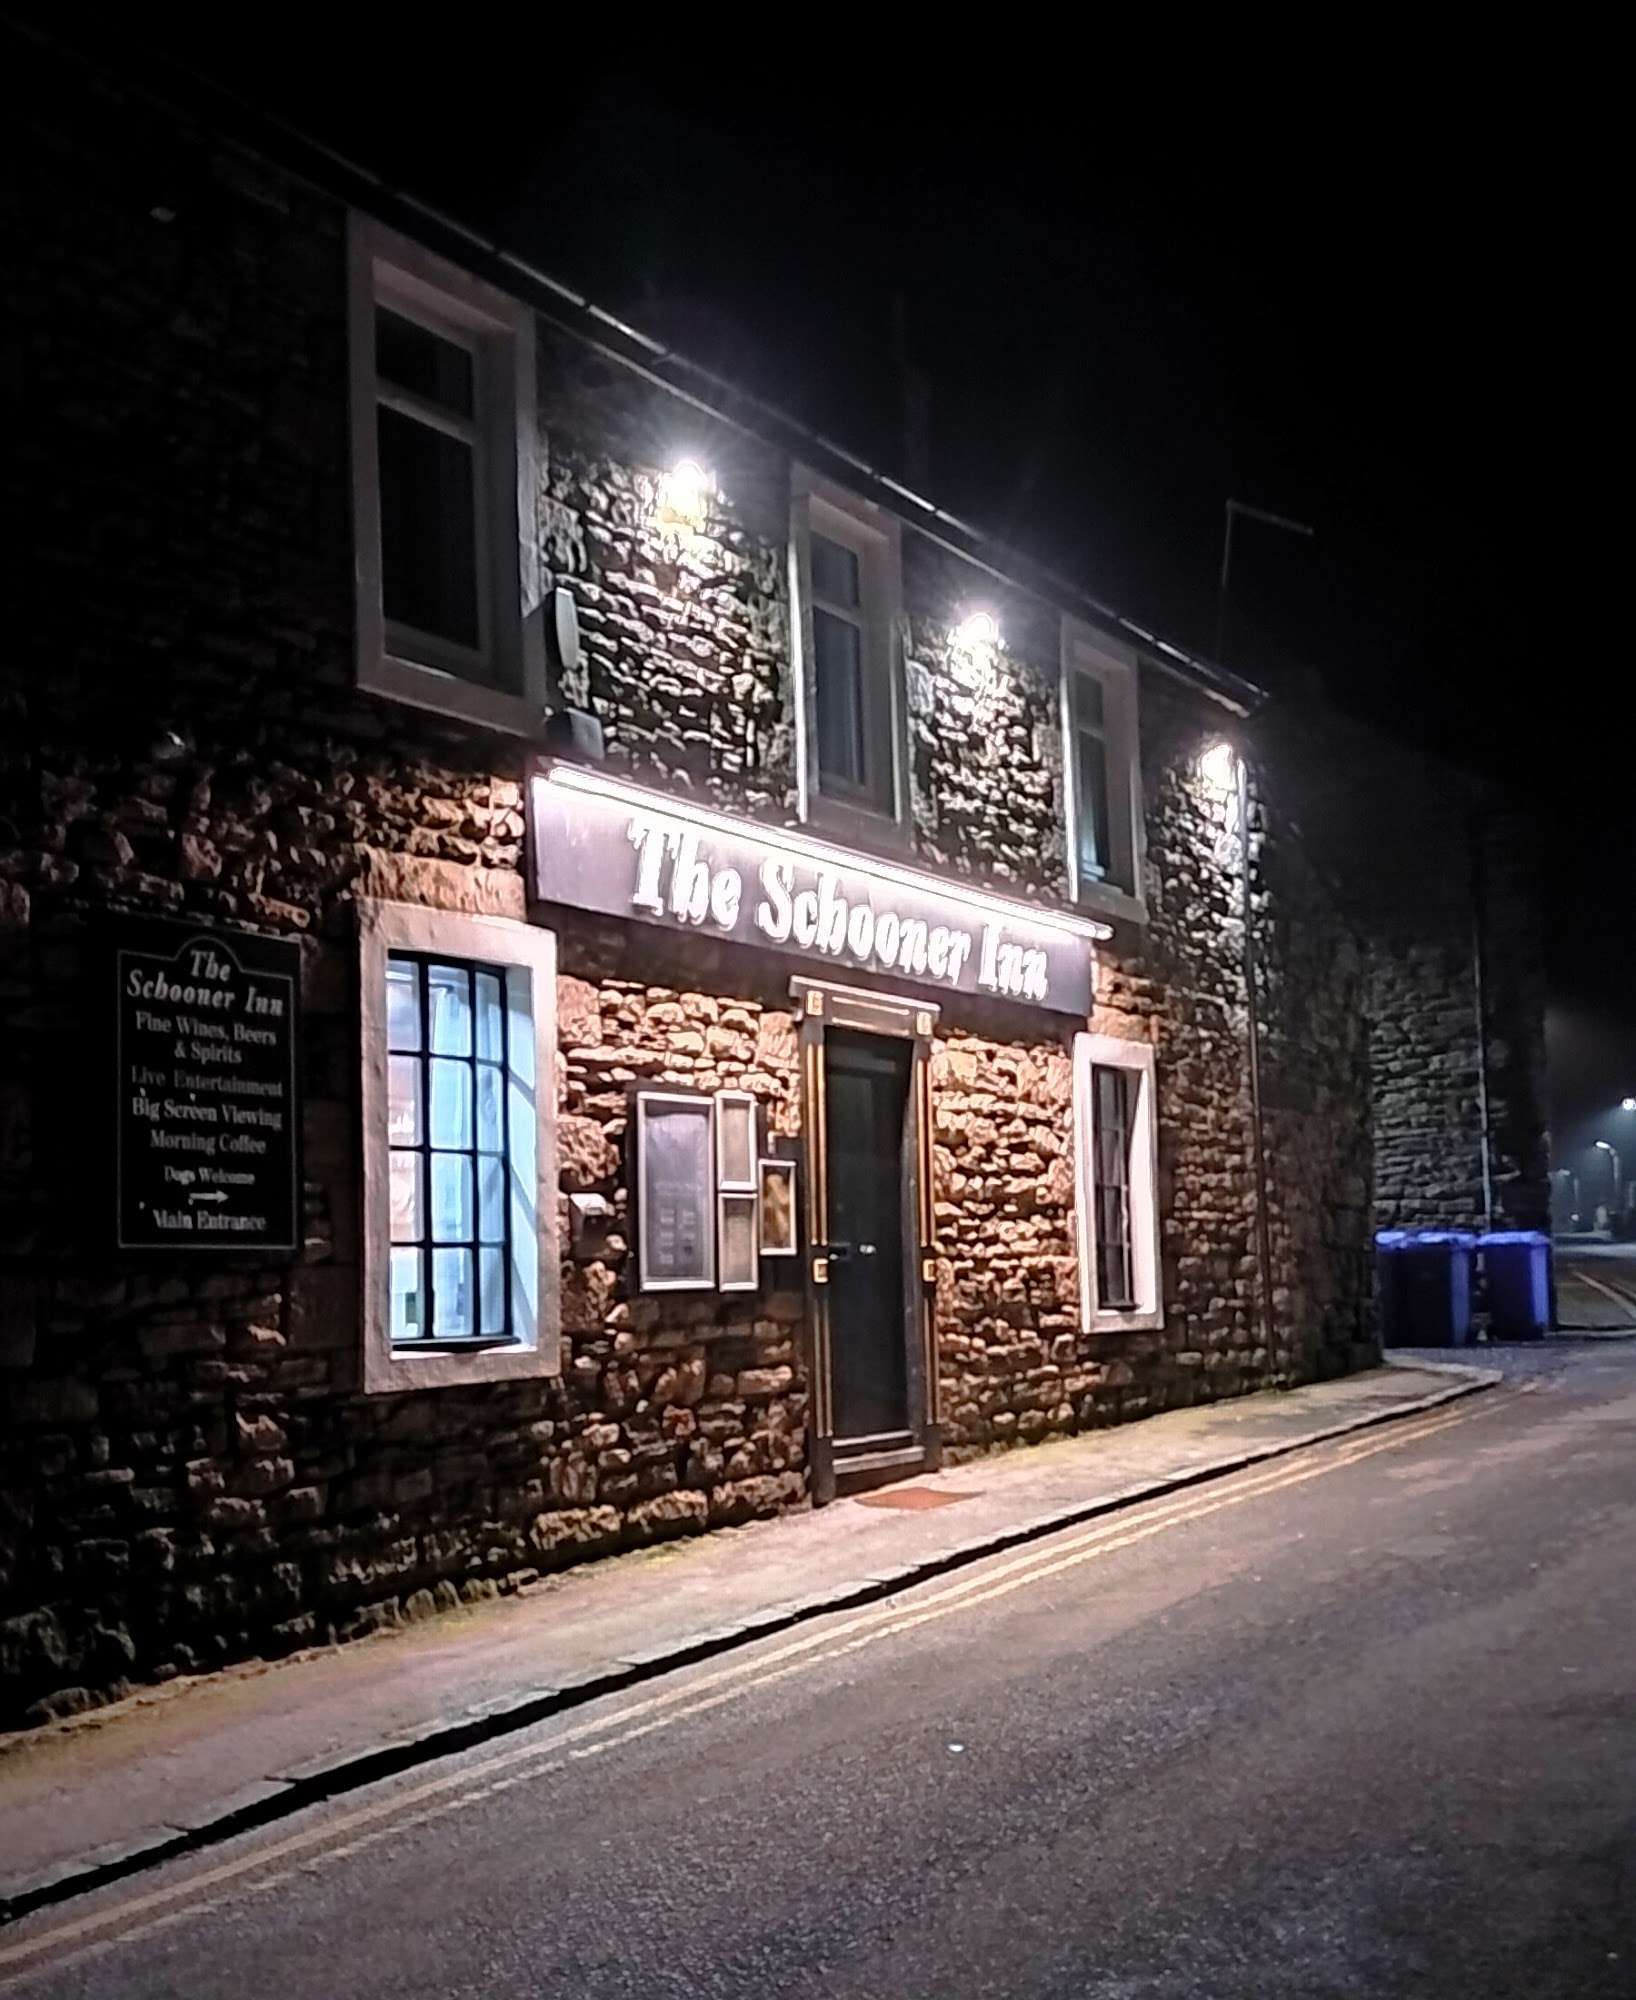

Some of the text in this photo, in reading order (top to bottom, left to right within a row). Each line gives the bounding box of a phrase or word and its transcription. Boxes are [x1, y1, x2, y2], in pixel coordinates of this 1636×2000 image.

[627, 815, 1049, 1000] The Schooner Inn
[190, 949, 230, 982] The
[126, 969, 283, 1017] Schooner Inn
[135, 1011, 276, 1045] Fine Wines, Beers
[175, 1041, 242, 1065] & Spirits
[131, 1065, 283, 1097] Live Entertainment
[132, 1097, 282, 1131] Big Screen Viewing
[150, 1130, 266, 1156] Morning Coffee
[164, 1165, 255, 1184] Dogs Welcome
[153, 1209, 266, 1231] Main Entrance
